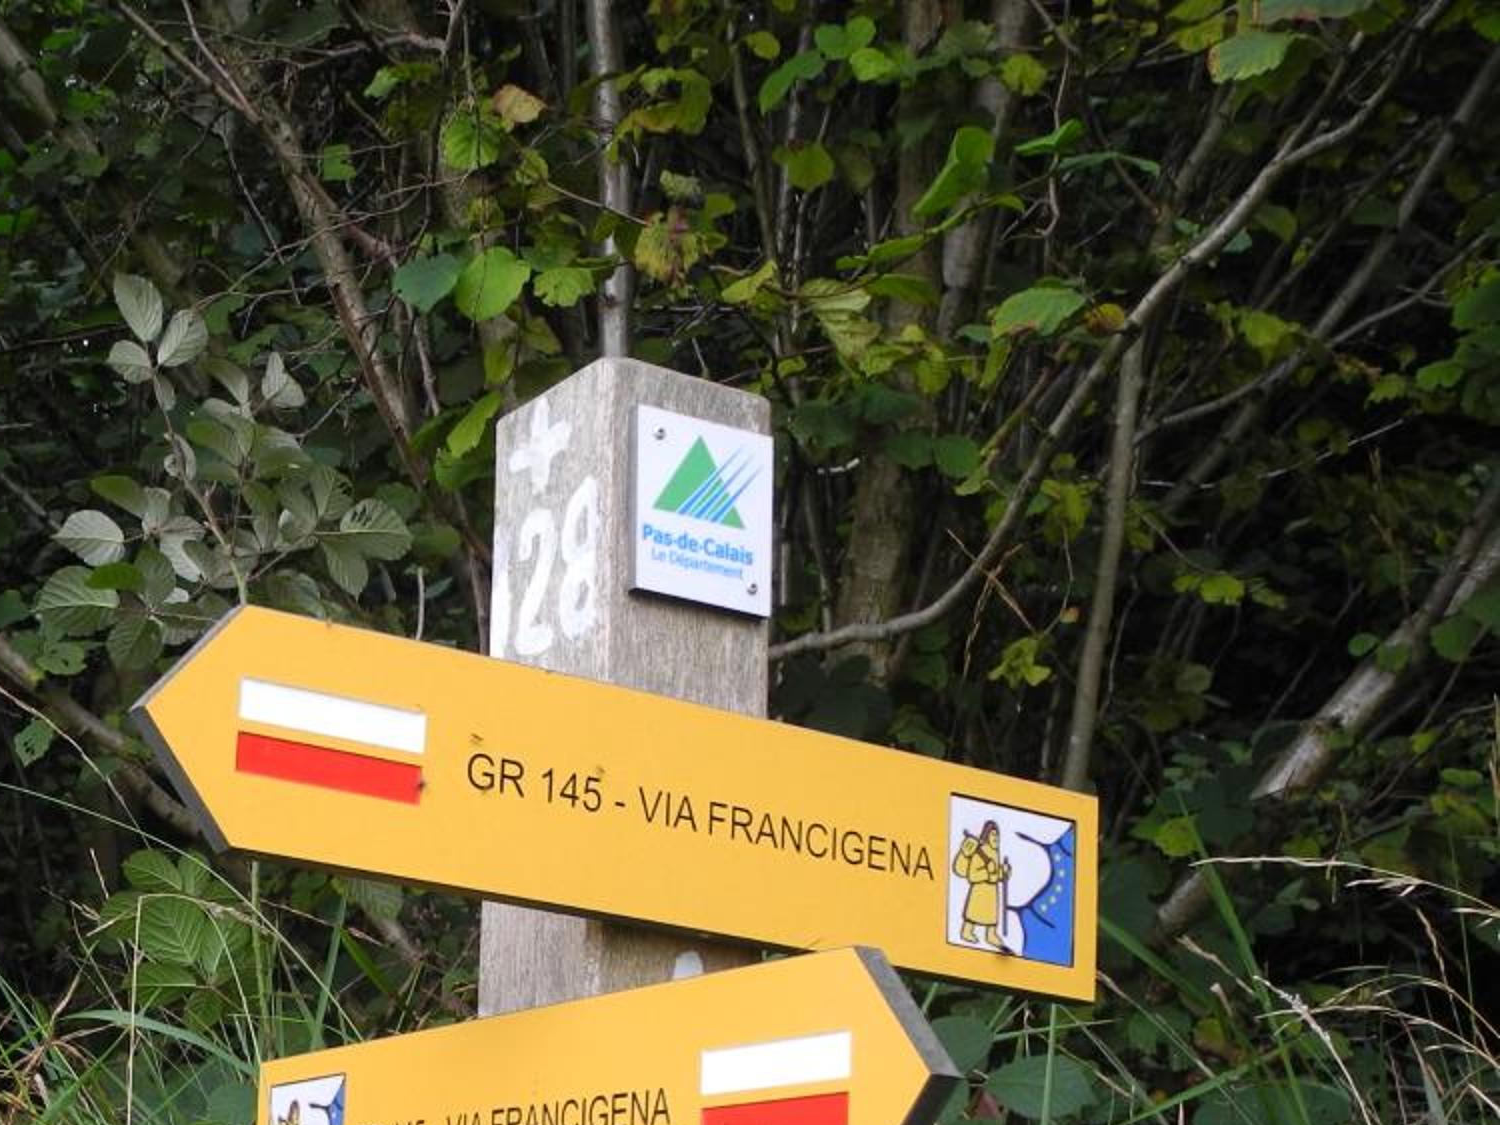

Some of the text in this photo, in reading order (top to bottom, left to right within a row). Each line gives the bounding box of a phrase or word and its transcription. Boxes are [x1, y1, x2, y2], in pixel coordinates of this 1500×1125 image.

[490, 475, 600, 658] 128
[642, 523, 754, 566] Pas-de-Calais
[651, 547, 743, 580] Le Départt
[466, 753, 525, 799] GR
[541, 767, 602, 813] 145
[638, 786, 697, 833] VIA
[707, 800, 935, 881] FRANCIGENA
